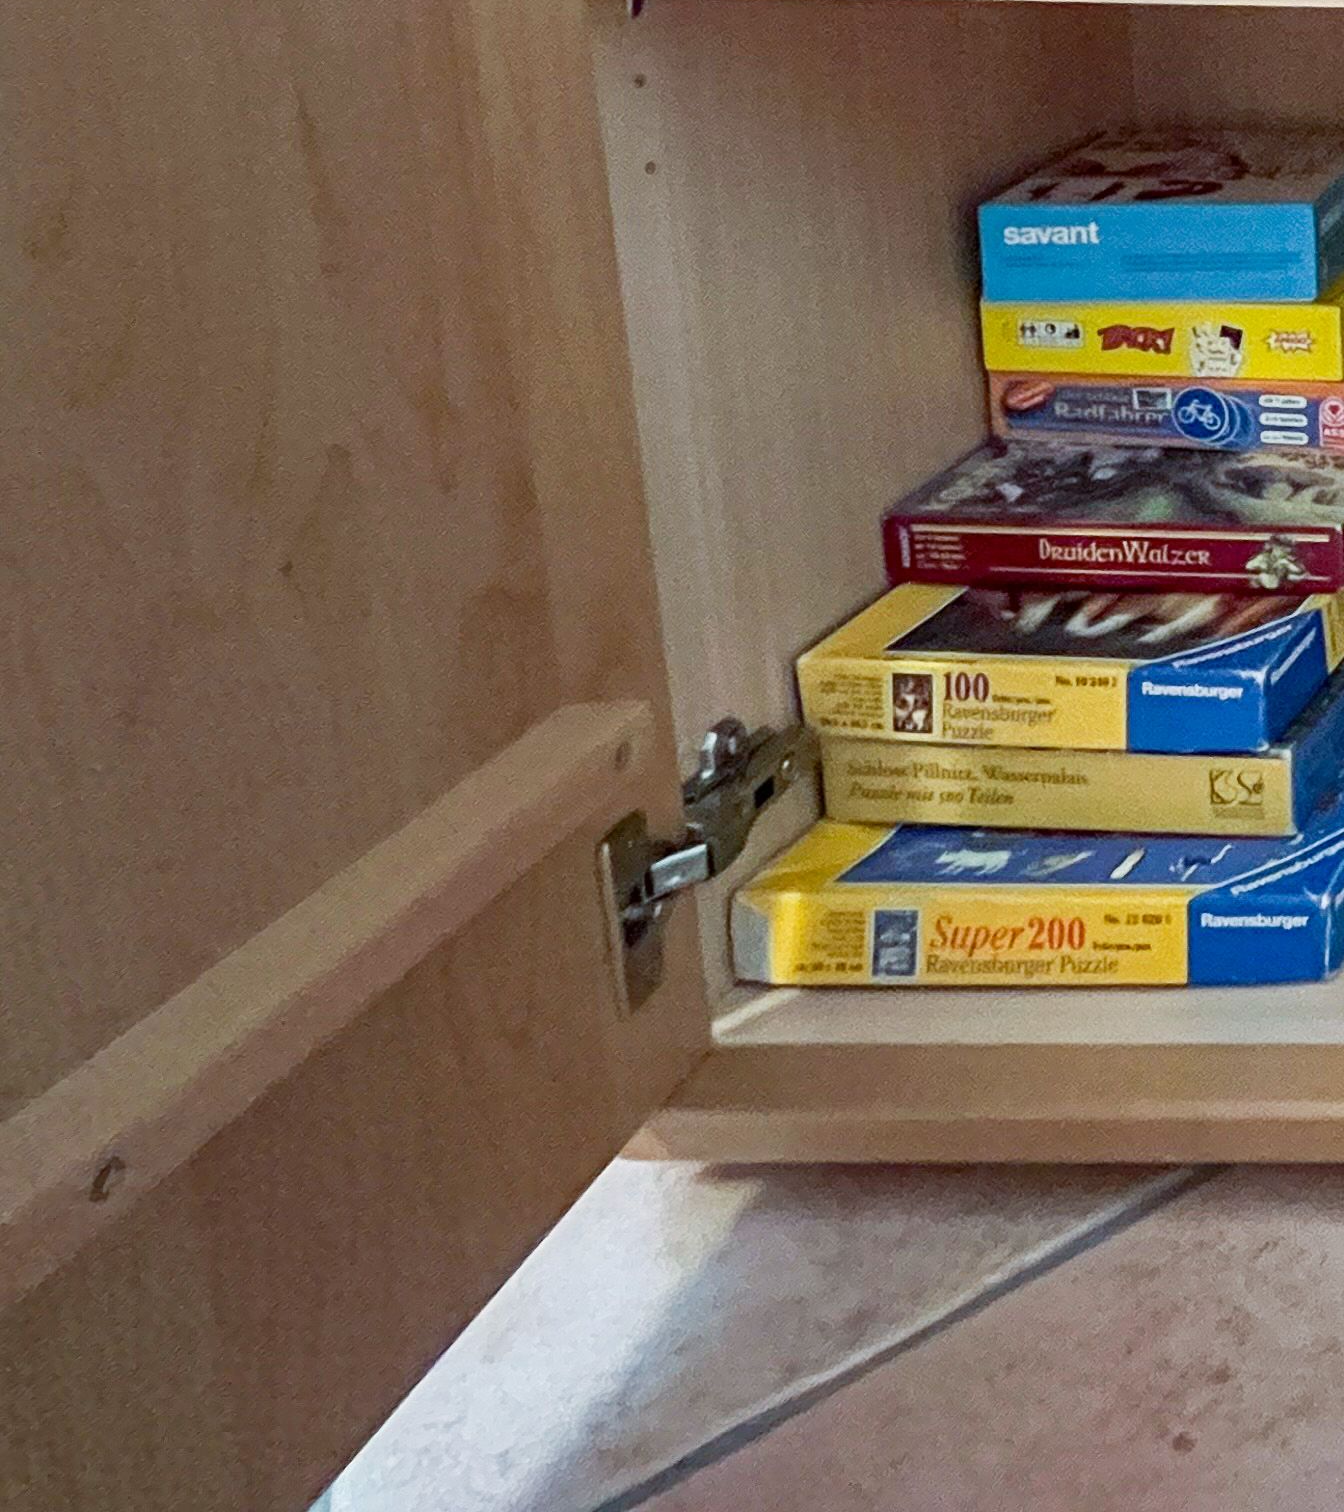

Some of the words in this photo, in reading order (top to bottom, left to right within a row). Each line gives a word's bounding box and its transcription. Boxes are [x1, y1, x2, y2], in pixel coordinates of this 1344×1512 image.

[1003, 221, 1101, 246] savant
[1054, 401, 1169, 424] Radfahrer
[942, 671, 990, 703] 100
[1141, 680, 1244, 701] Ravensburger
[942, 701, 1054, 725] Ravensburger
[942, 724, 994, 740] Puzzle
[1200, 912, 1310, 930] Ravensburger
[929, 914, 1025, 958] Super
[1026, 915, 1087, 952] 200
[925, 954, 1055, 976] Ravensburger
[1058, 954, 1120, 976] Puzzle
